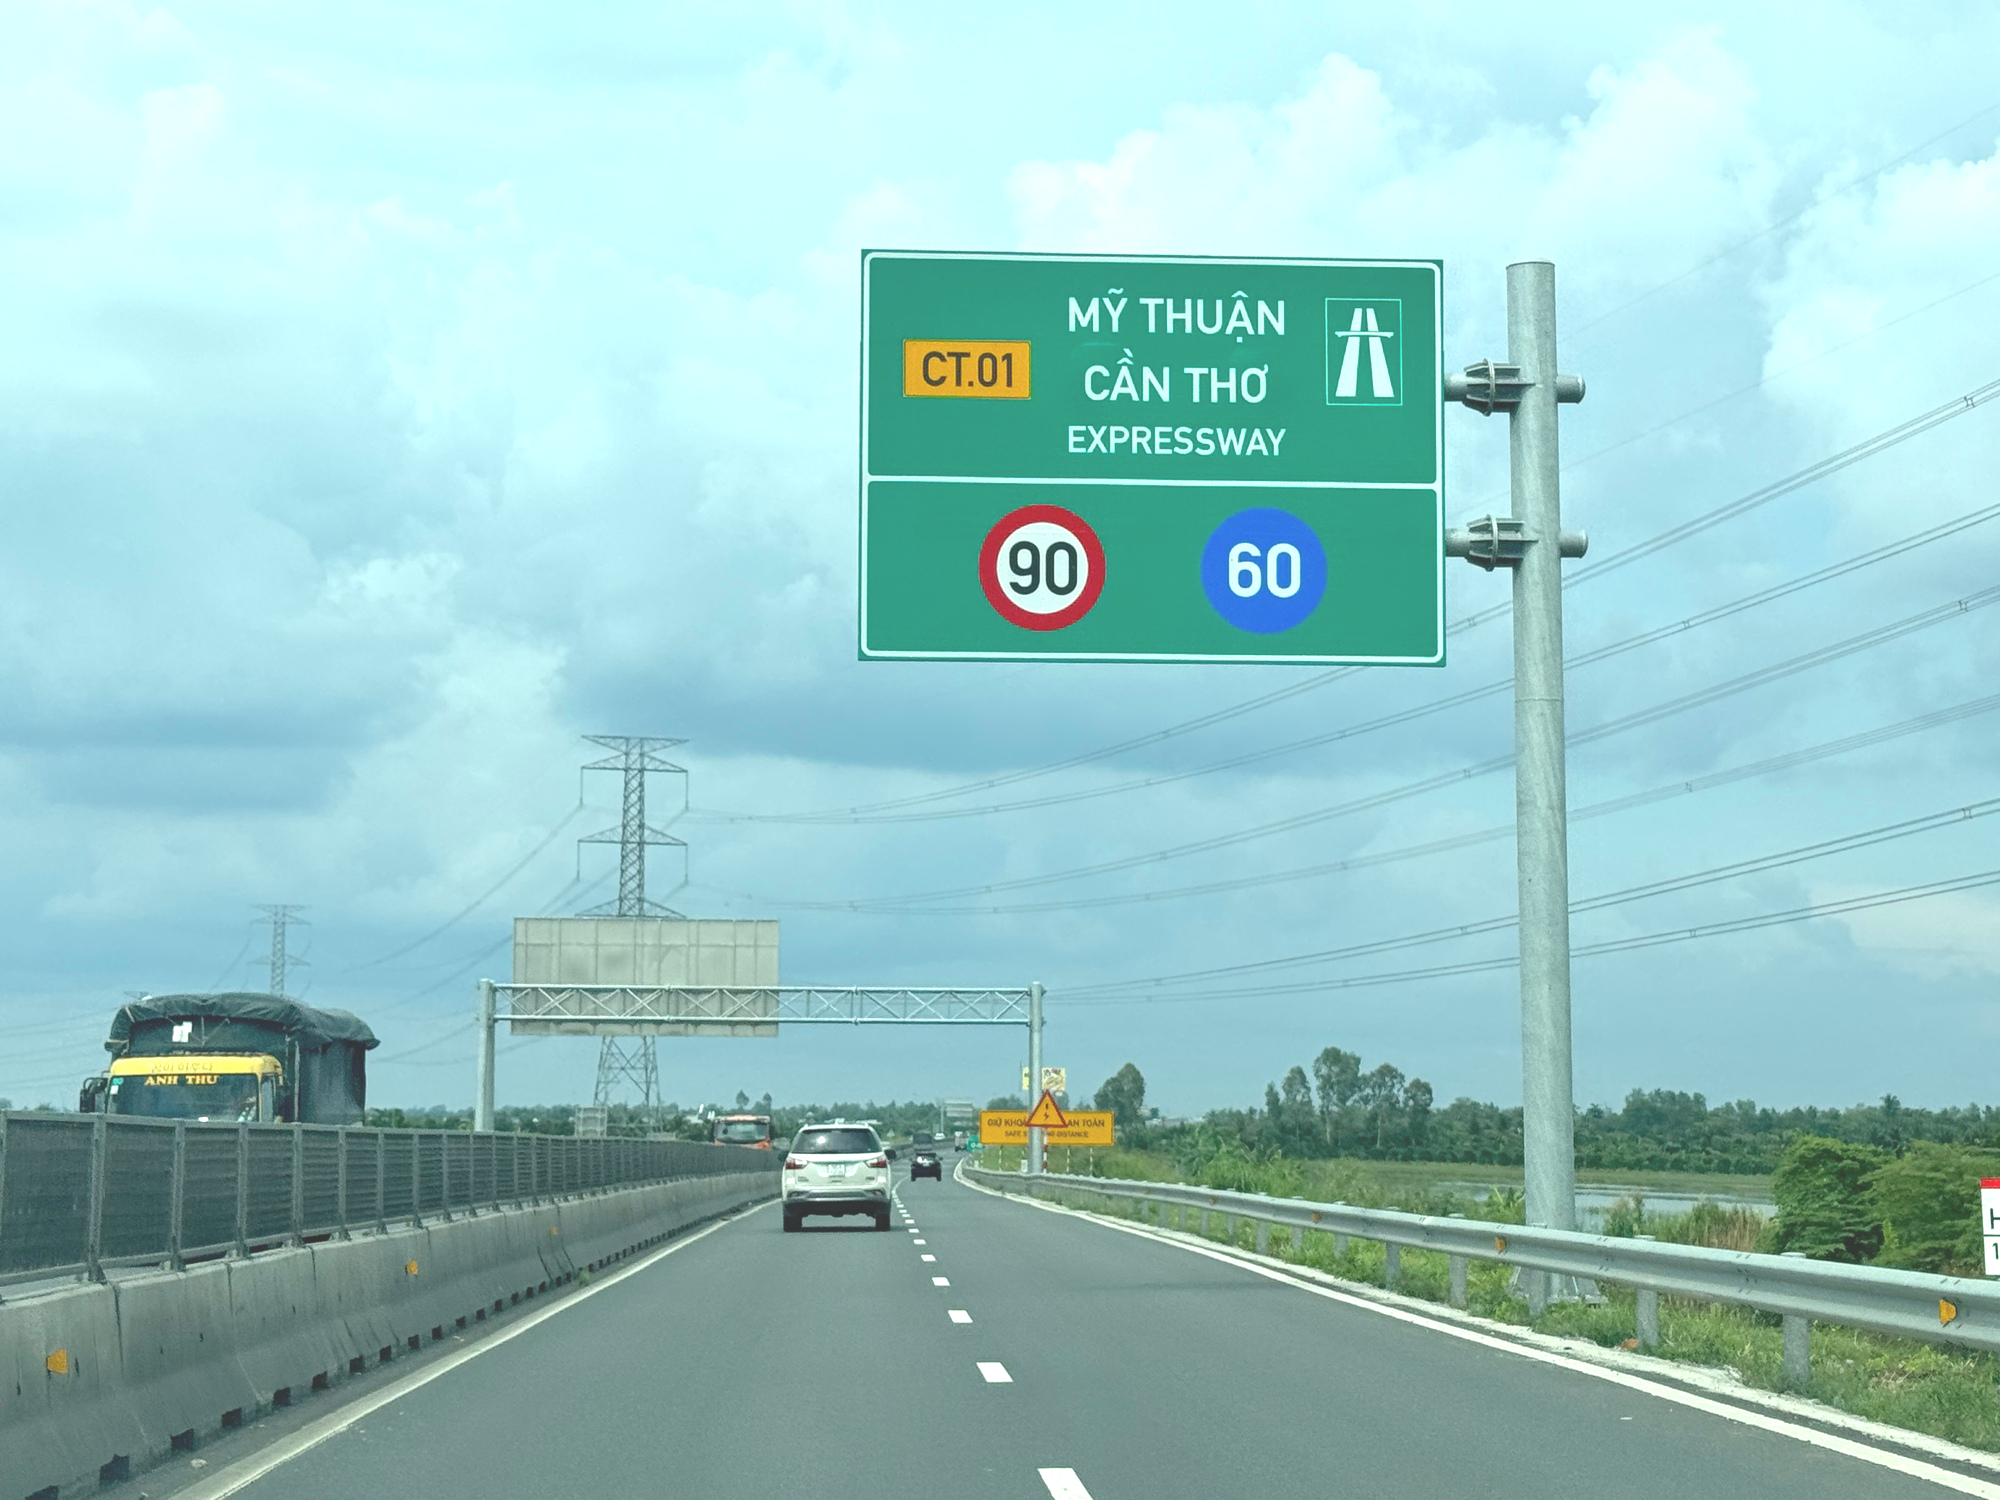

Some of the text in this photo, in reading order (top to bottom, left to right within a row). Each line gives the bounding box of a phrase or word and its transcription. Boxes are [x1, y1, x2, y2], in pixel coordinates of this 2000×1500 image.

[1068, 288, 1285, 343] MỸ THUẬN
[922, 350, 1013, 388] CT.01
[1084, 347, 1269, 403] CẦN THƠ
[1068, 425, 1287, 457] EXPRESSWAY
[1009, 541, 1078, 596] 90
[1228, 542, 1301, 599] 60
[144, 1075, 179, 1086] ANH
